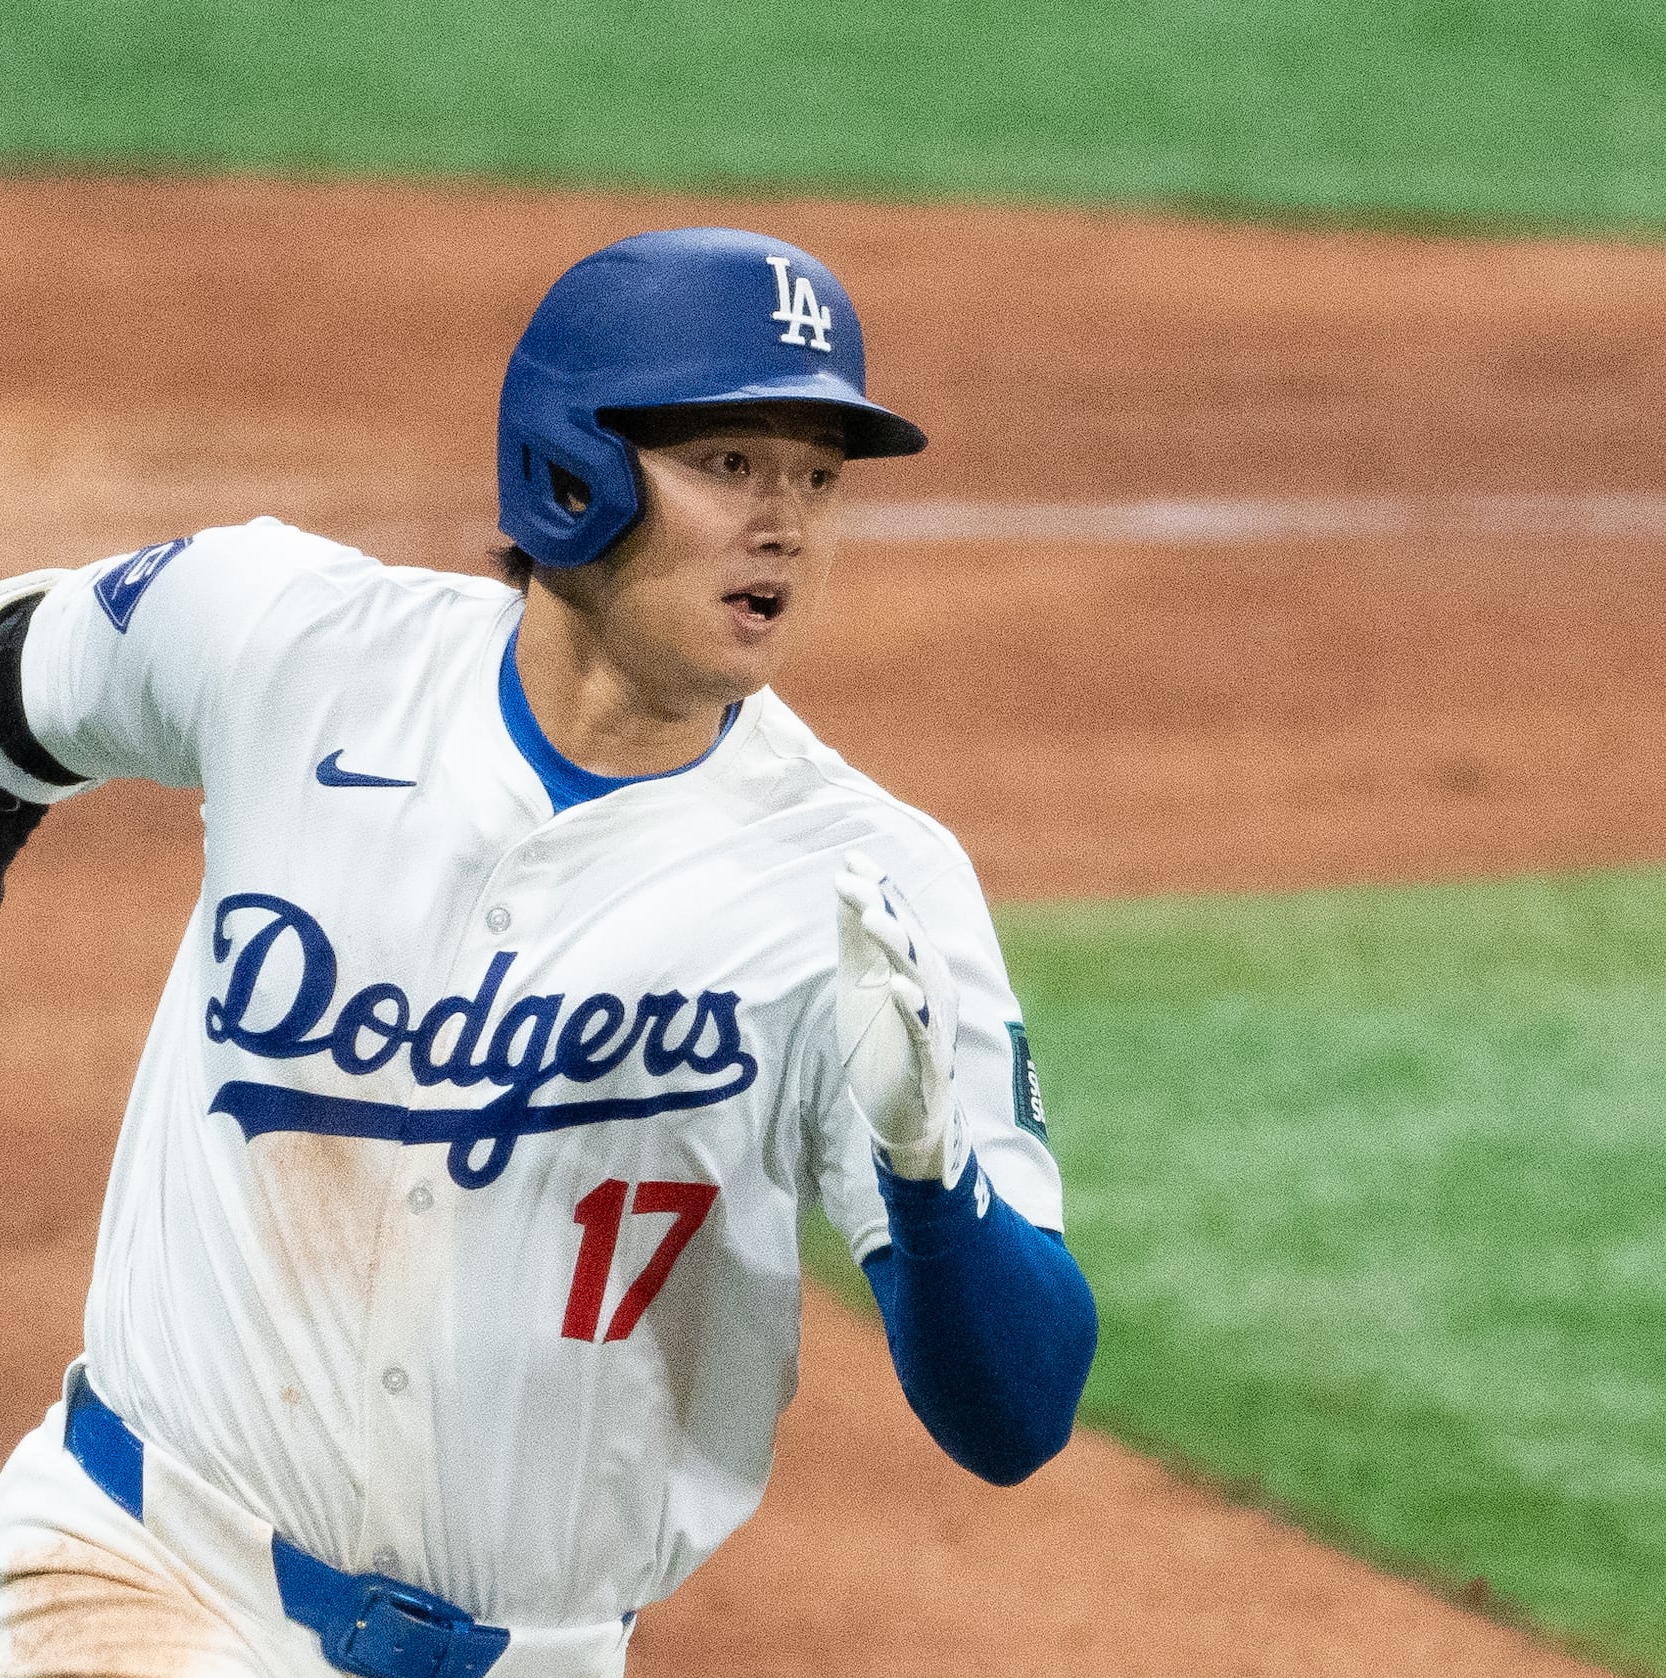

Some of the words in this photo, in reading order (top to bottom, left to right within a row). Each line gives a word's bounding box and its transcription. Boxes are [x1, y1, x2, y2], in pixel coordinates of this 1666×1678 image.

[766, 256, 832, 352] LA
[205, 892, 758, 1189] Dodgers
[561, 1177, 721, 1344] 17
